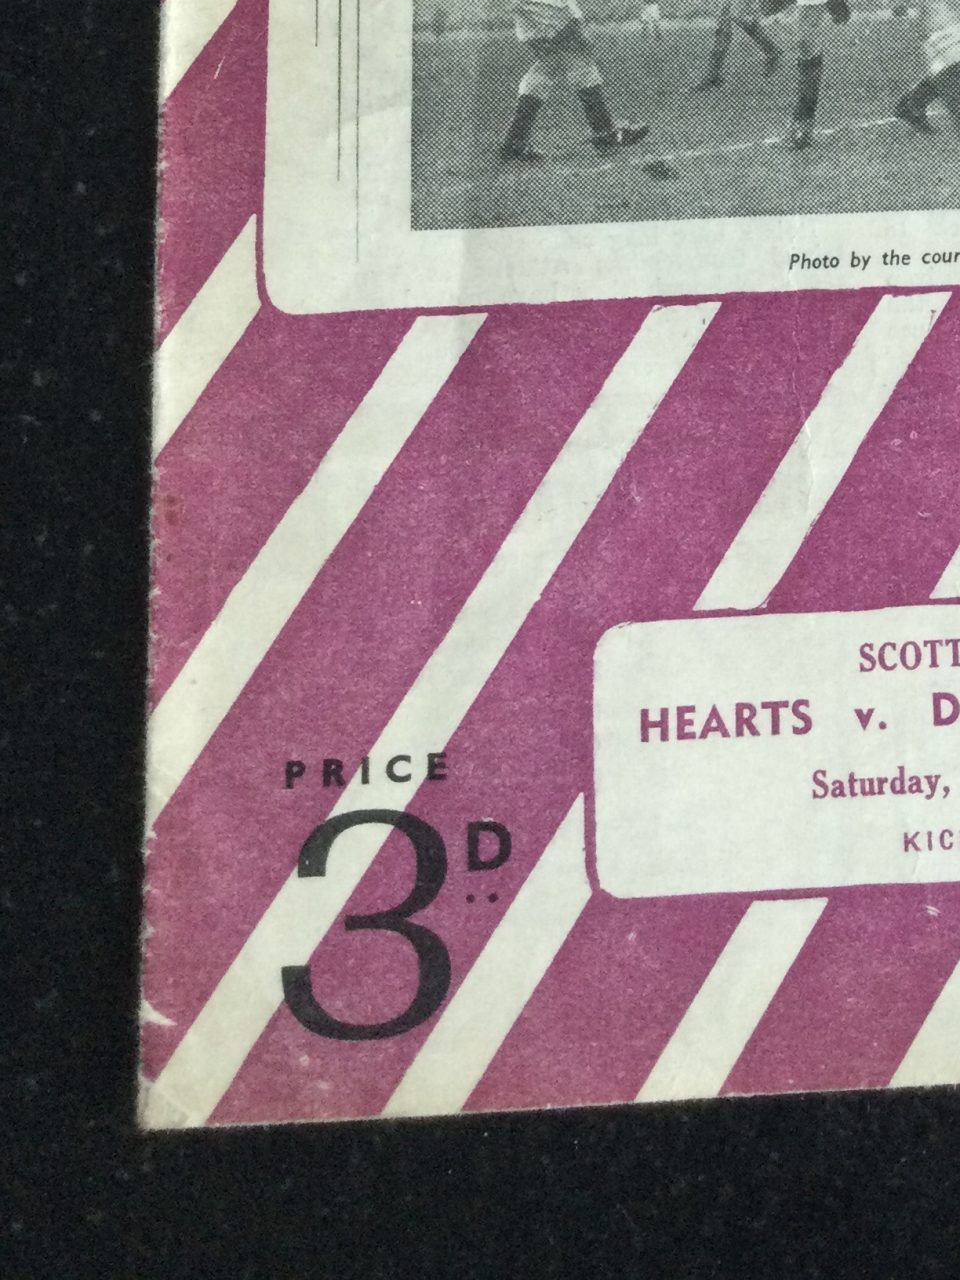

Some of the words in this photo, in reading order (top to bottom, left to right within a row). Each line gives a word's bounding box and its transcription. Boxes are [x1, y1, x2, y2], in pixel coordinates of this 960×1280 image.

[788, 252, 840, 271] Photo
[850, 250, 872, 271] by
[881, 249, 911, 266] the
[639, 698, 813, 743] HEARTS
[853, 707, 887, 731] v.
[284, 752, 448, 790] PRICE
[812, 765, 951, 801] Saturday,
